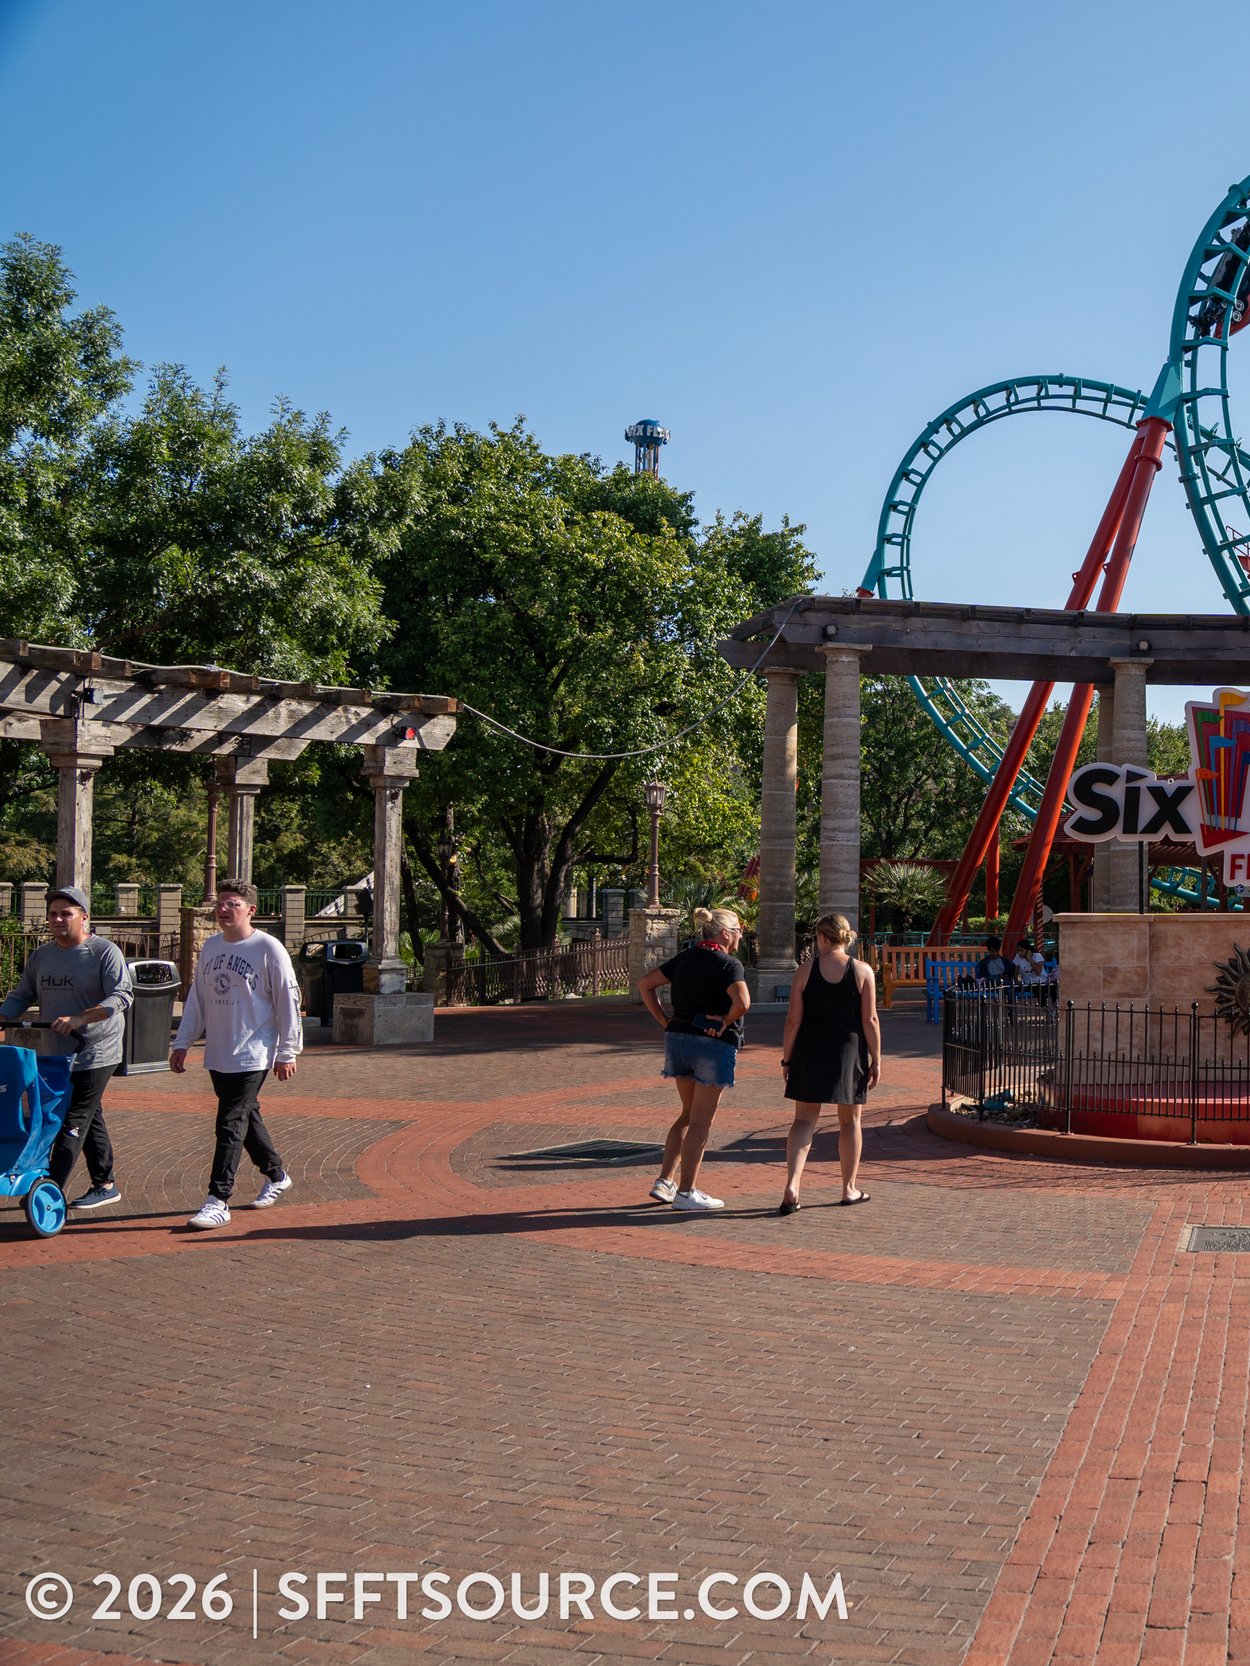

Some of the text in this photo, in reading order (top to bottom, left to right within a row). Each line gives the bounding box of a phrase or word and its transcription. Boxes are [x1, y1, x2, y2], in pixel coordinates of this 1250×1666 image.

[628, 425, 671, 441] SIX FLAG
[1070, 768, 1195, 835] Six
[213, 954, 226, 970] OF
[226, 954, 259, 991] ANGELS
